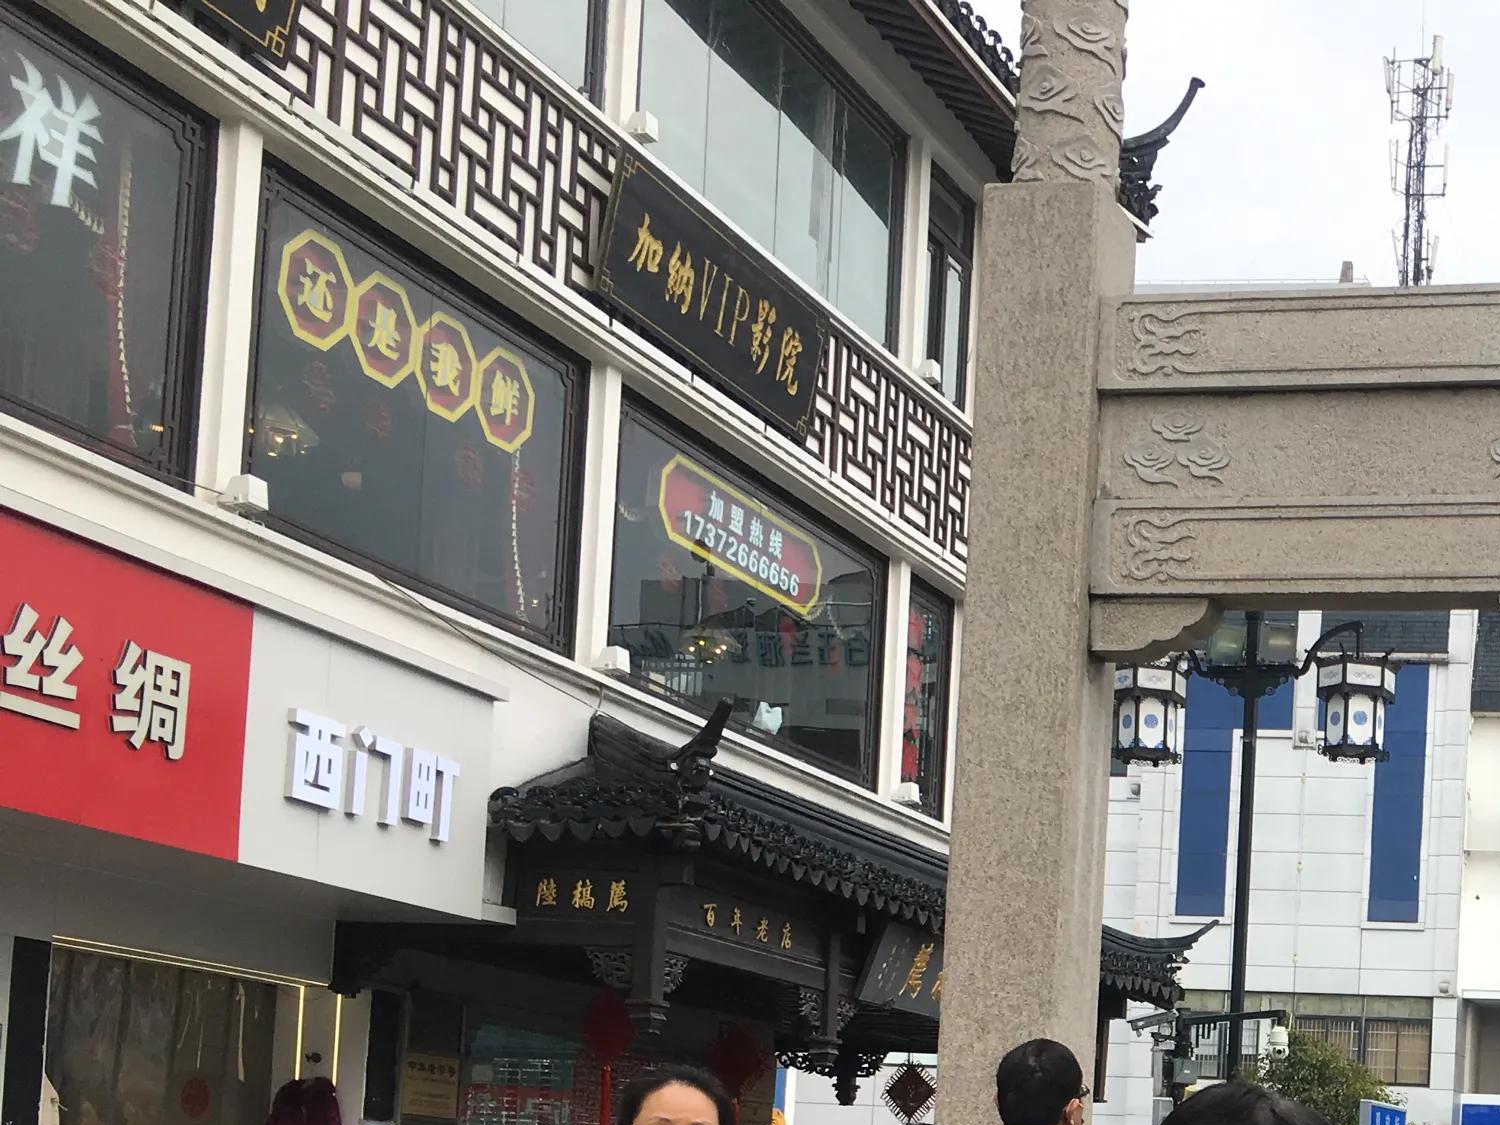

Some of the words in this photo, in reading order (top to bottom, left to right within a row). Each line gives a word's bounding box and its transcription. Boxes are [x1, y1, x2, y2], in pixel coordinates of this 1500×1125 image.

[0, 51, 104, 208] 祥
[684, 510, 800, 598] 17372666656
[707, 490, 783, 560] 加盟热线
[0, 602, 191, 760] 丝绸
[284, 707, 460, 842] 西门町
[703, 903, 793, 950] 百年老店
